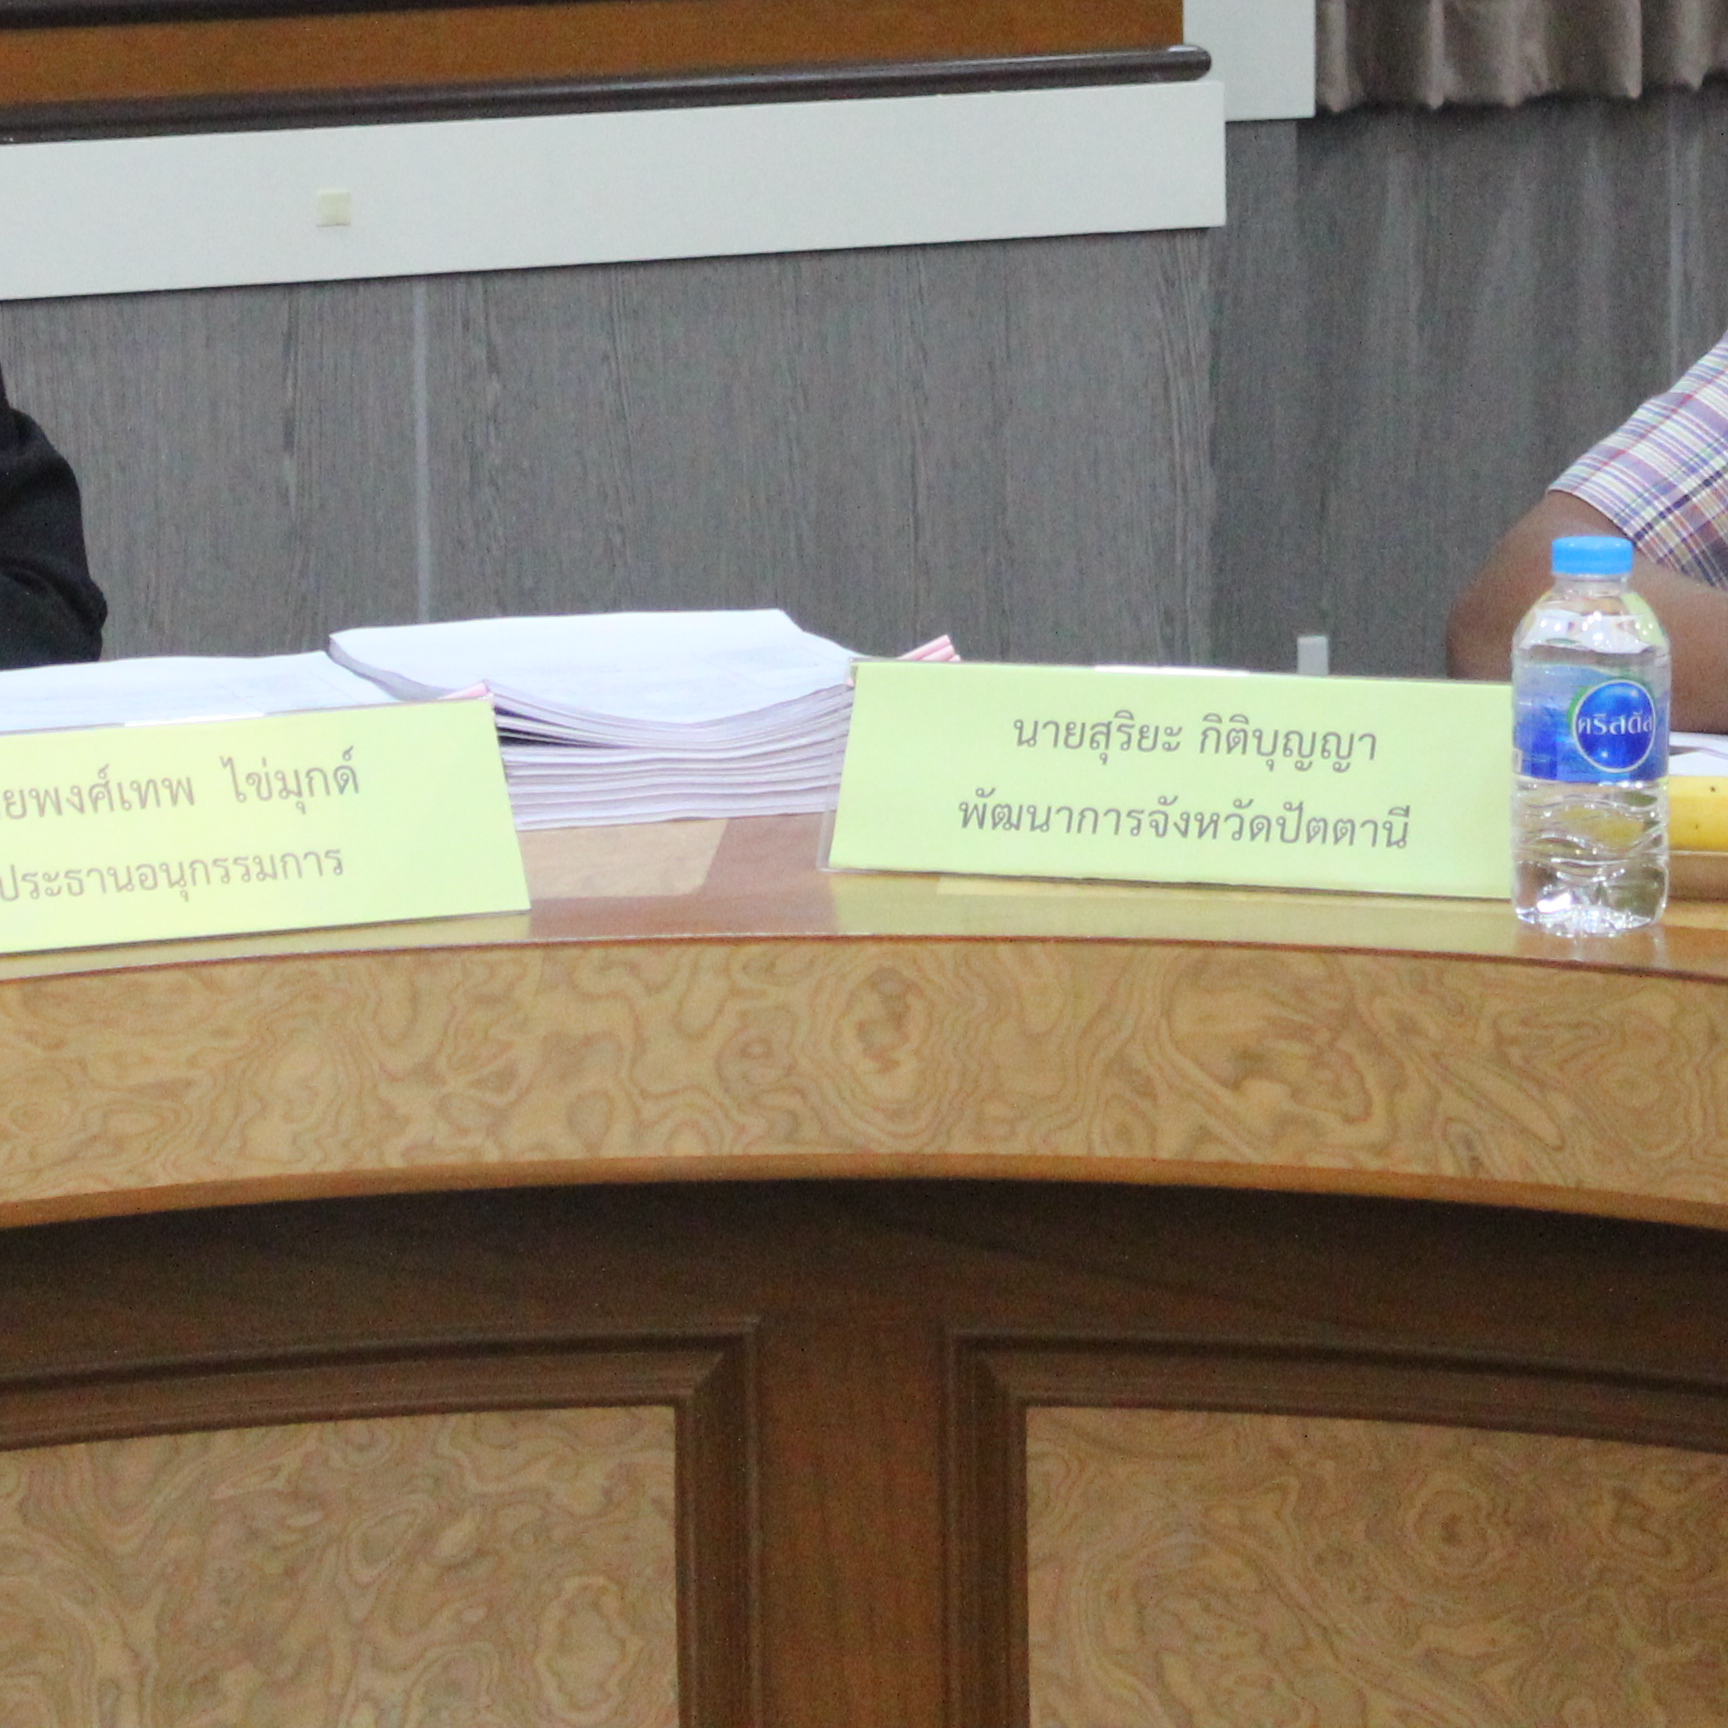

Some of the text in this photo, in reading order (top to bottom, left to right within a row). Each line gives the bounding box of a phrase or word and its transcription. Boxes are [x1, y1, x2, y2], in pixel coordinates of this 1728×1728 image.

[1013, 709, 1378, 773] นายสุริยะ กิติบุญญา
[219, 745, 360, 815] ไข่มุกด์
[958, 787, 1412, 850] พัฒนาการจังหวัดปัตตานี
